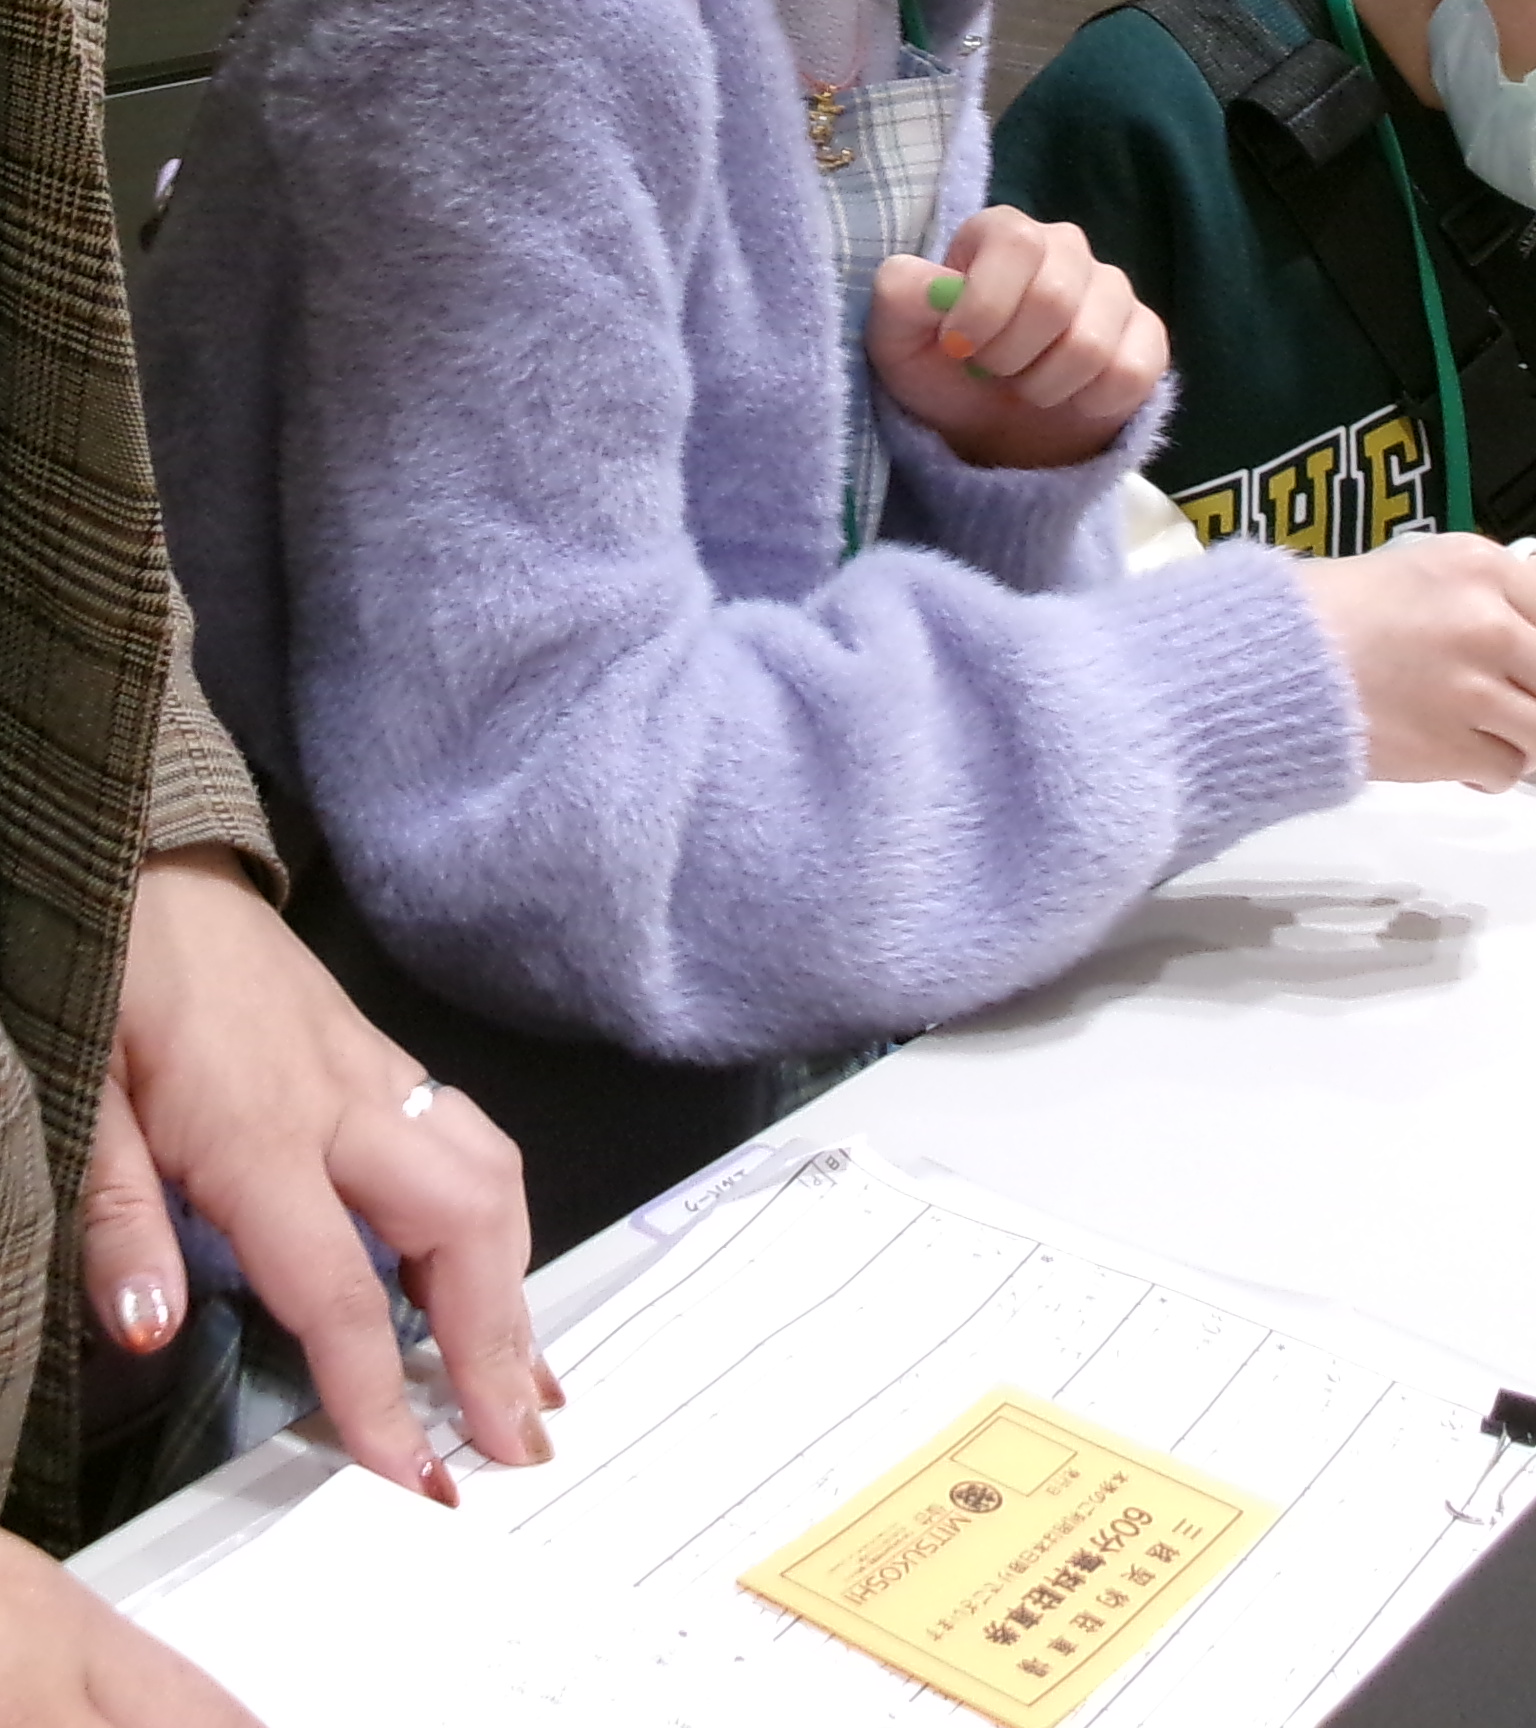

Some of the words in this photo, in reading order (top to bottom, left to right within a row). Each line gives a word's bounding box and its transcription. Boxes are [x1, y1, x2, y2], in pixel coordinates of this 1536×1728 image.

[842, 1511, 973, 1607] MITSUKOSHI
[982, 1505, 1154, 1647] 60分無料駐車券
